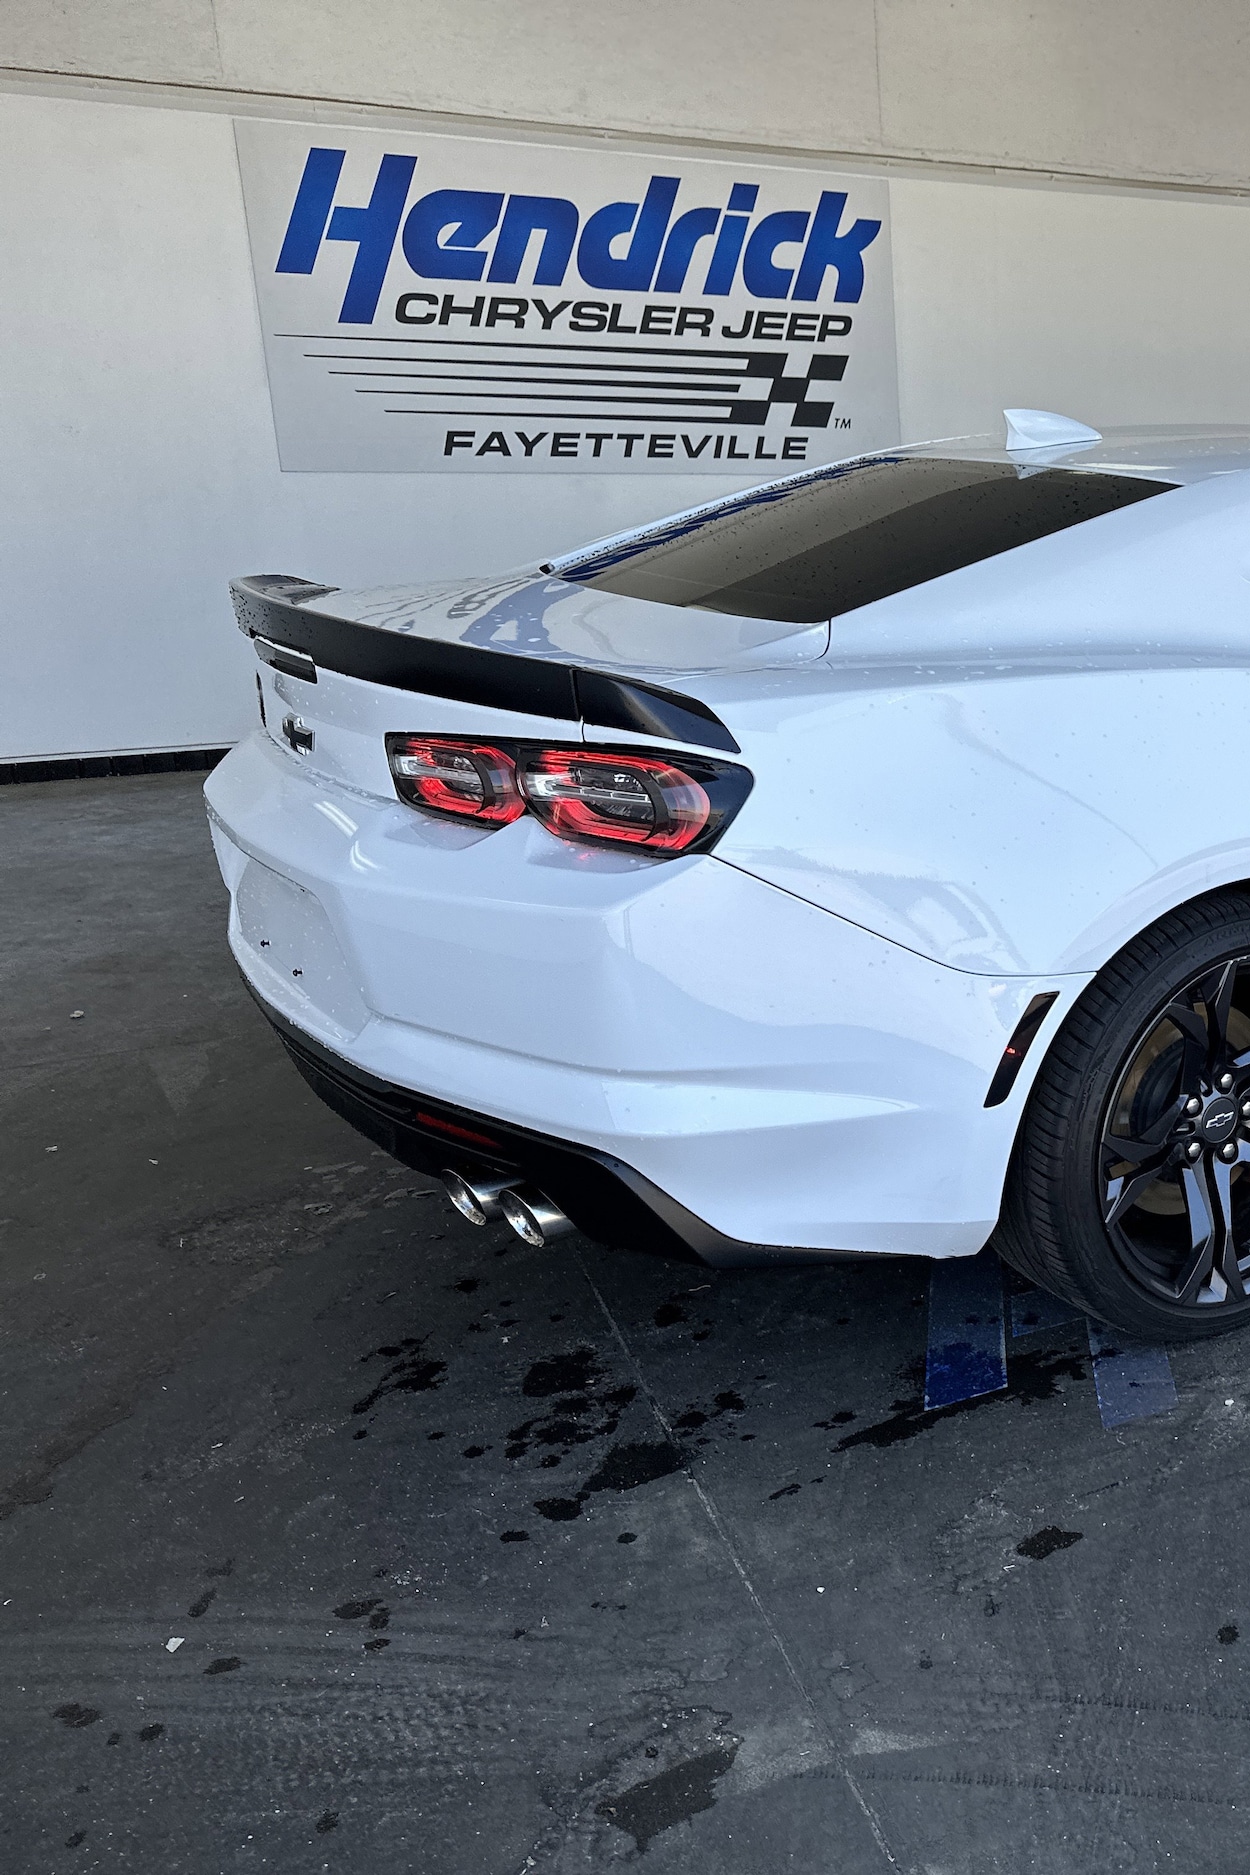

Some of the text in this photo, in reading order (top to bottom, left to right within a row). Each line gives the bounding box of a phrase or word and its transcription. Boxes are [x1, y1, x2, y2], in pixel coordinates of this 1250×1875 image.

[274, 147, 882, 325] Hendrick
[394, 292, 853, 343] CHRYSLER JEEP
[833, 417, 853, 430] TM
[443, 430, 809, 460] FAYETTEVILLE
